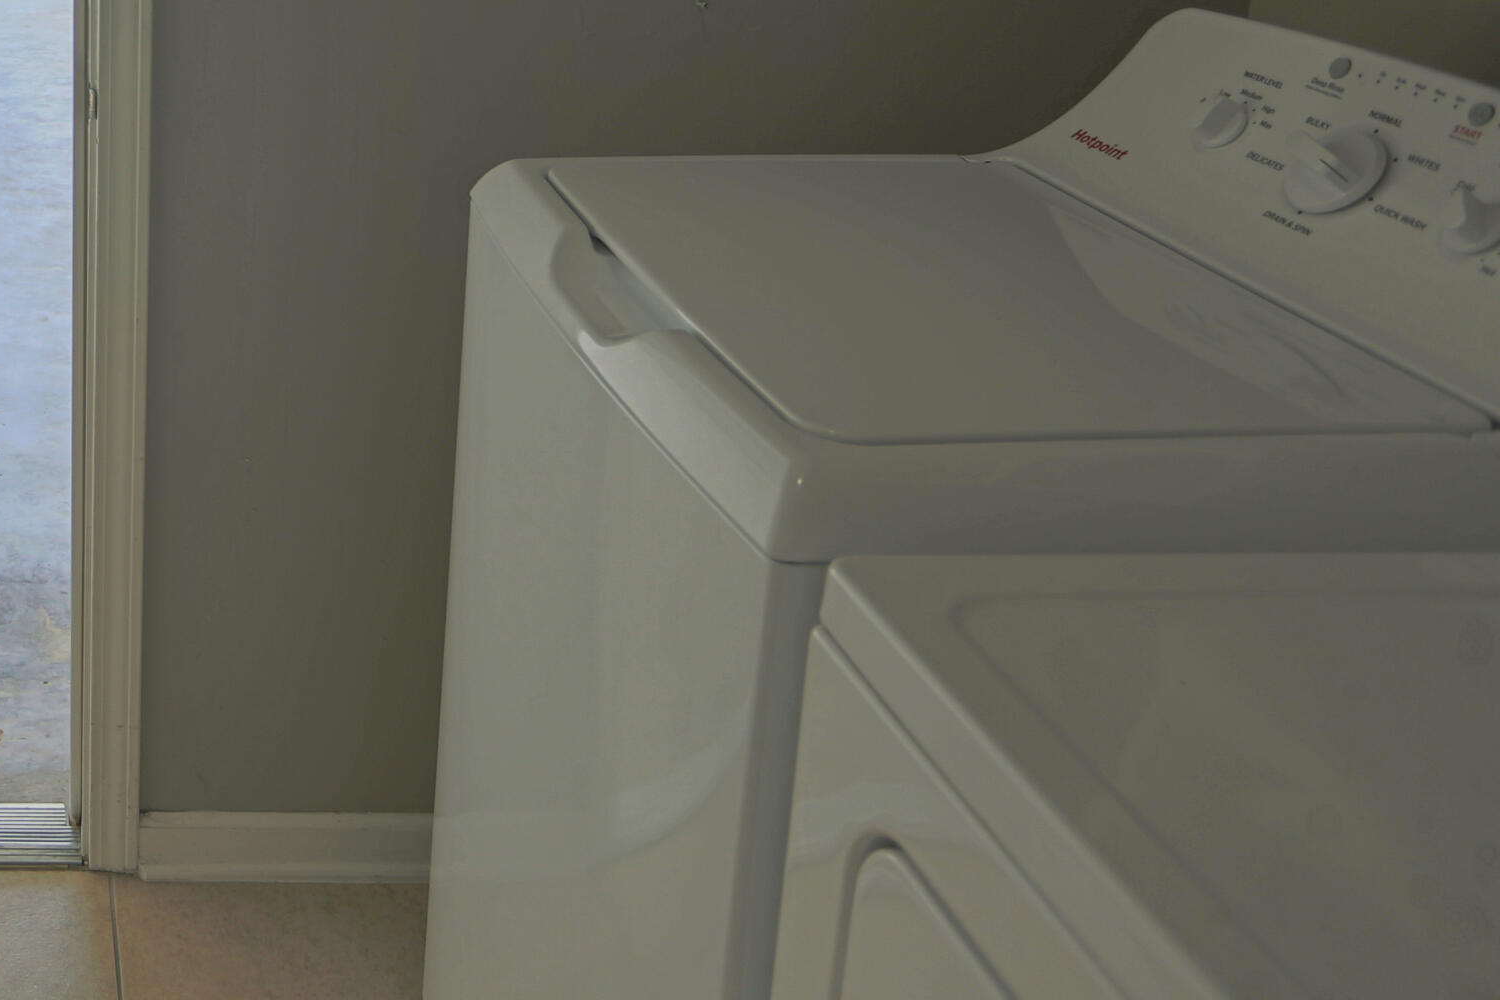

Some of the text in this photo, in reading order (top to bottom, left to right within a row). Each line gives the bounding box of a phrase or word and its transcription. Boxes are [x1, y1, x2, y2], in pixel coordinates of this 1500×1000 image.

[1244, 70, 1264, 82] WATER
[1305, 116, 1332, 129] BULKY
[1368, 109, 1402, 127] NORMAL
[1453, 124, 1484, 140] START
[1070, 129, 1129, 160] Hotpoint
[1246, 151, 1284, 171] DELICATES
[1408, 153, 1441, 171] WHITES
[1262, 210, 1286, 225] DRAIN
[1292, 224, 1313, 236] SPIN
[1374, 204, 1428, 230] QUICK WASH
